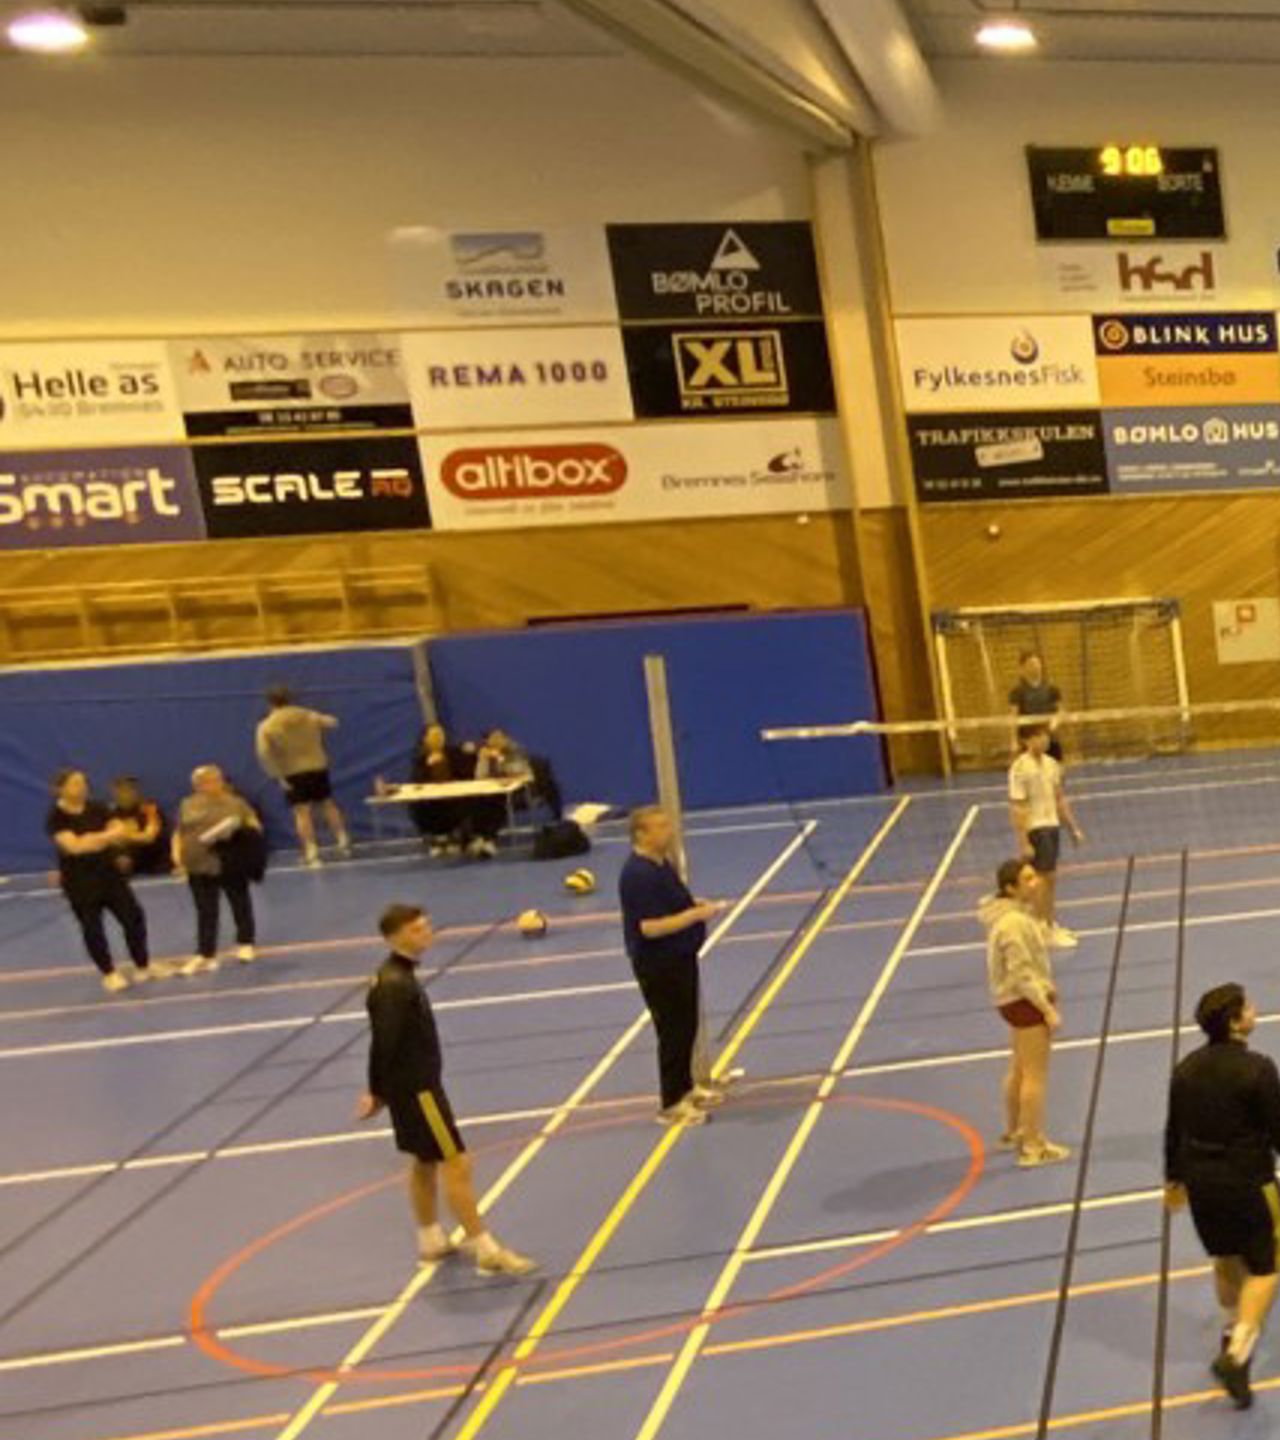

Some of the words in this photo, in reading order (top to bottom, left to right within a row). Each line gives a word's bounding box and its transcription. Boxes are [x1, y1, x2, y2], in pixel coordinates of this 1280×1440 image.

[445, 278, 565, 299] SKAGEN
[651, 271, 748, 294] BØMLO
[695, 292, 791, 314] PROFIL
[1132, 324, 1211, 345] BLINK
[1218, 323, 1269, 343] HUS
[223, 354, 289, 372] AUTO
[301, 349, 400, 369] SERVICE
[683, 339, 777, 387] XL
[13, 370, 109, 399] Helle
[118, 373, 160, 396] as
[428, 363, 526, 388] REMA
[534, 359, 609, 384] 1000
[914, 364, 1085, 392] FylkesnesFisk
[917, 425, 1096, 446] TRAFIKKSKULEN
[1113, 423, 1200, 445] BØMLO
[1232, 421, 1279, 441] HUS
[455, 456, 613, 491] altibox
[211, 471, 363, 505] SCALE
